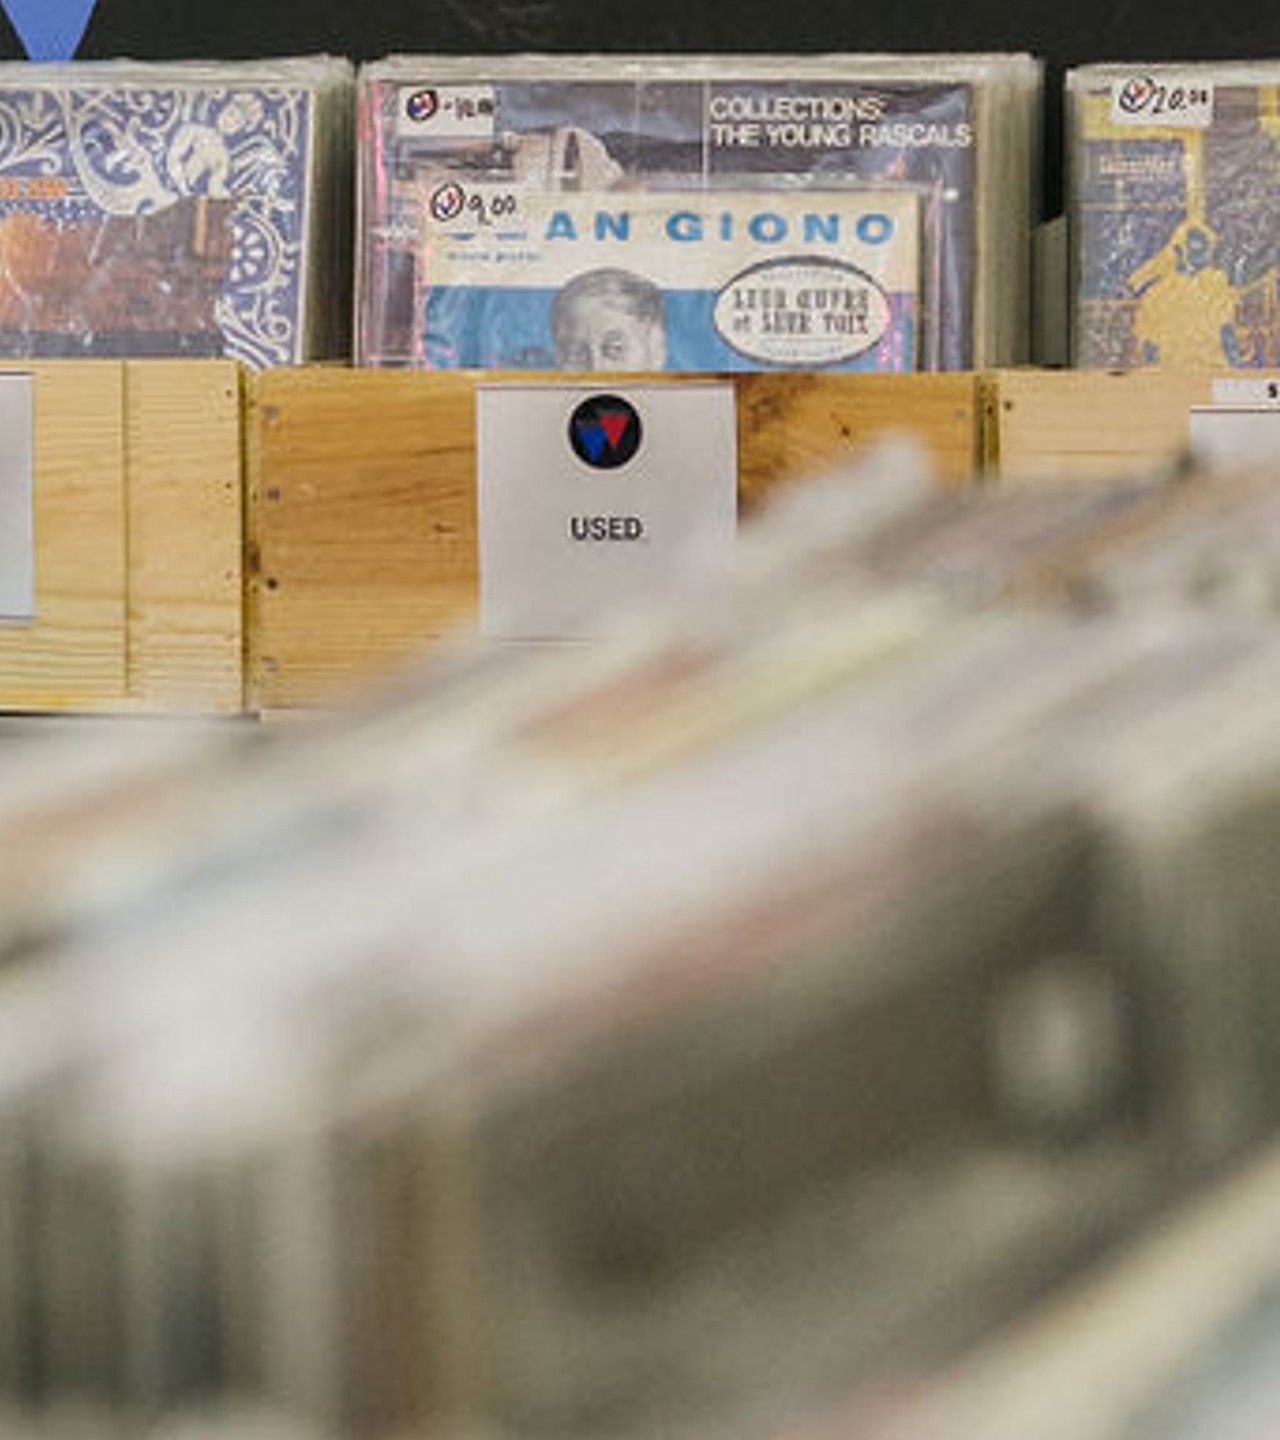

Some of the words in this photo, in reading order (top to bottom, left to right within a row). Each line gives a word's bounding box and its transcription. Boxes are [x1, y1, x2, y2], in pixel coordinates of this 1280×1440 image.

[710, 124, 760, 147] THE
[764, 124, 851, 148] YOUNG
[859, 123, 973, 147] RASCALS
[663, 211, 895, 244] GIONO
[570, 517, 644, 542] USED
